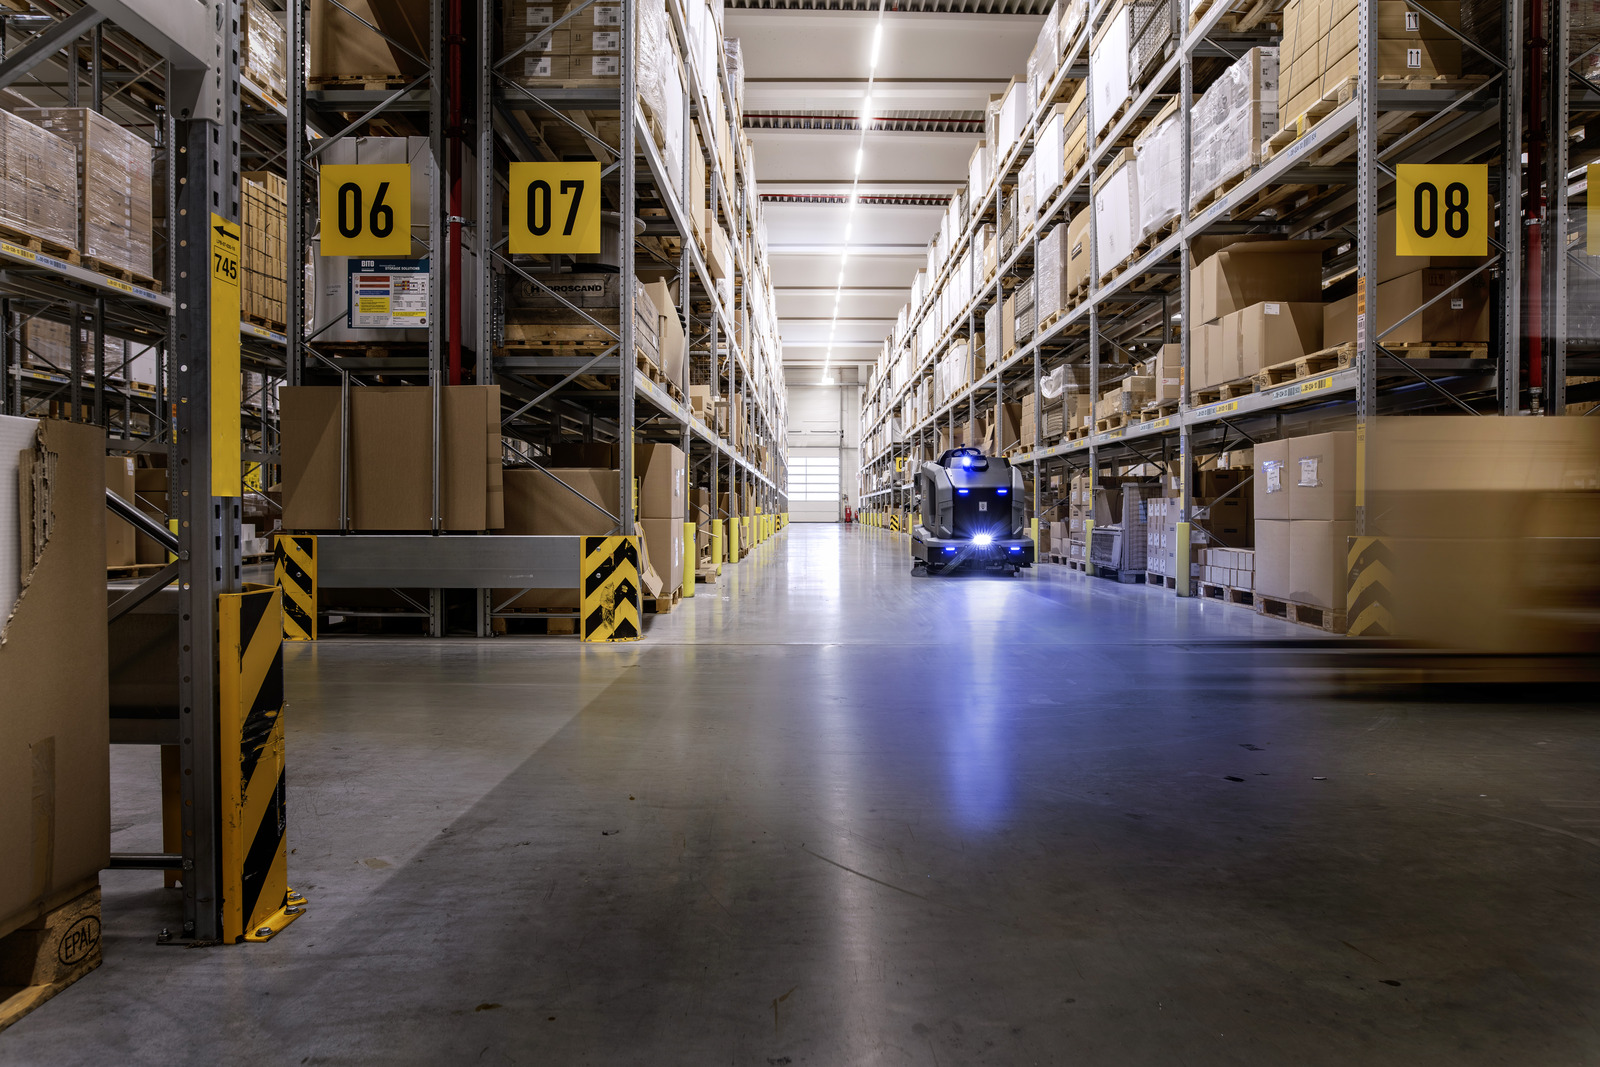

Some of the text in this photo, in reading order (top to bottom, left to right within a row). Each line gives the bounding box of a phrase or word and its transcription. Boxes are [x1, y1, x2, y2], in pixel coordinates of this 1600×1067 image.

[338, 182, 393, 238] 06
[527, 180, 584, 236] 07
[1414, 182, 1469, 238] 08
[214, 252, 237, 280] 745
[65, 923, 96, 960] EPAL
